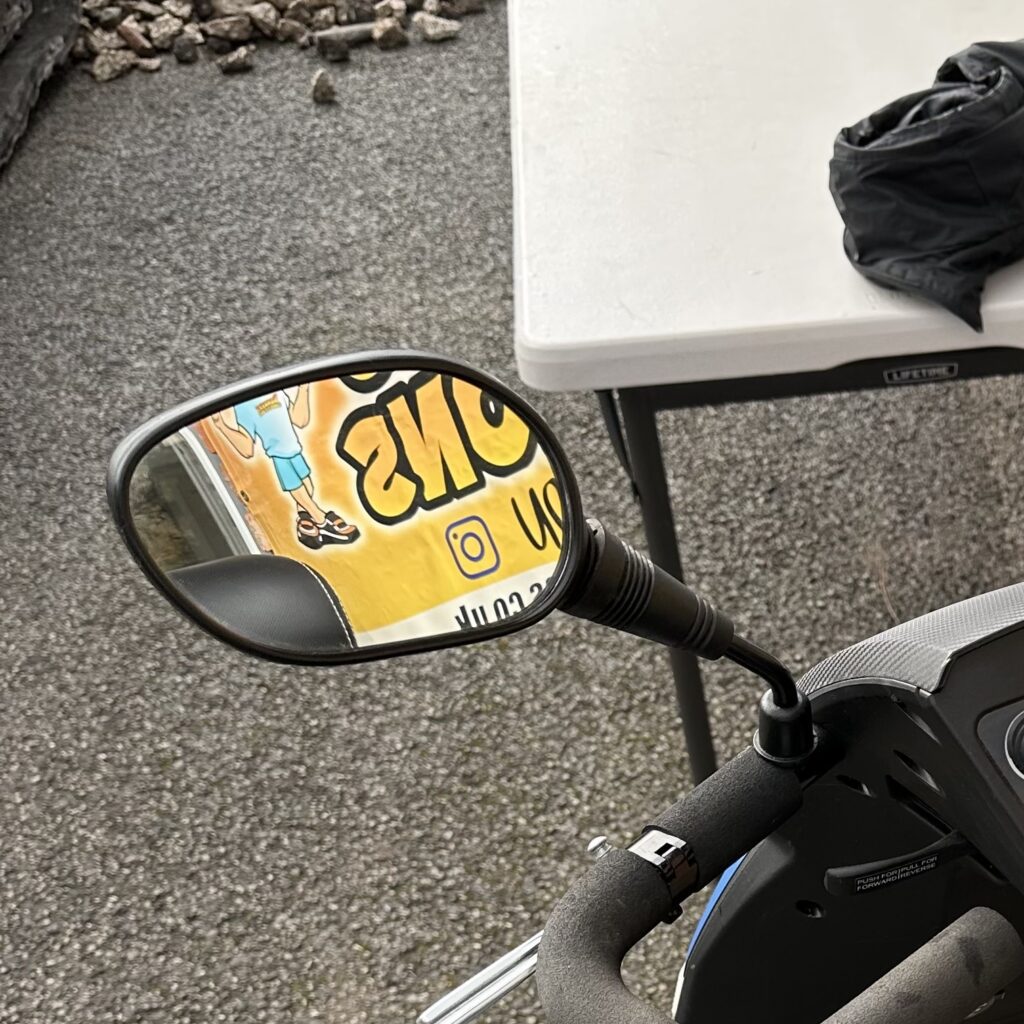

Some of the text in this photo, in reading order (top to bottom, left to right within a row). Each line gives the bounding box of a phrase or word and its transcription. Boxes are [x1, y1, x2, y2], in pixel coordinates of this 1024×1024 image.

[892, 366, 950, 380] LIFETIME
[900, 856, 938, 873] PULL FOR
[900, 863, 936, 879] REVERSE
[856, 876, 898, 892] FORWARD
[857, 869, 898, 885] PUSH FOR
